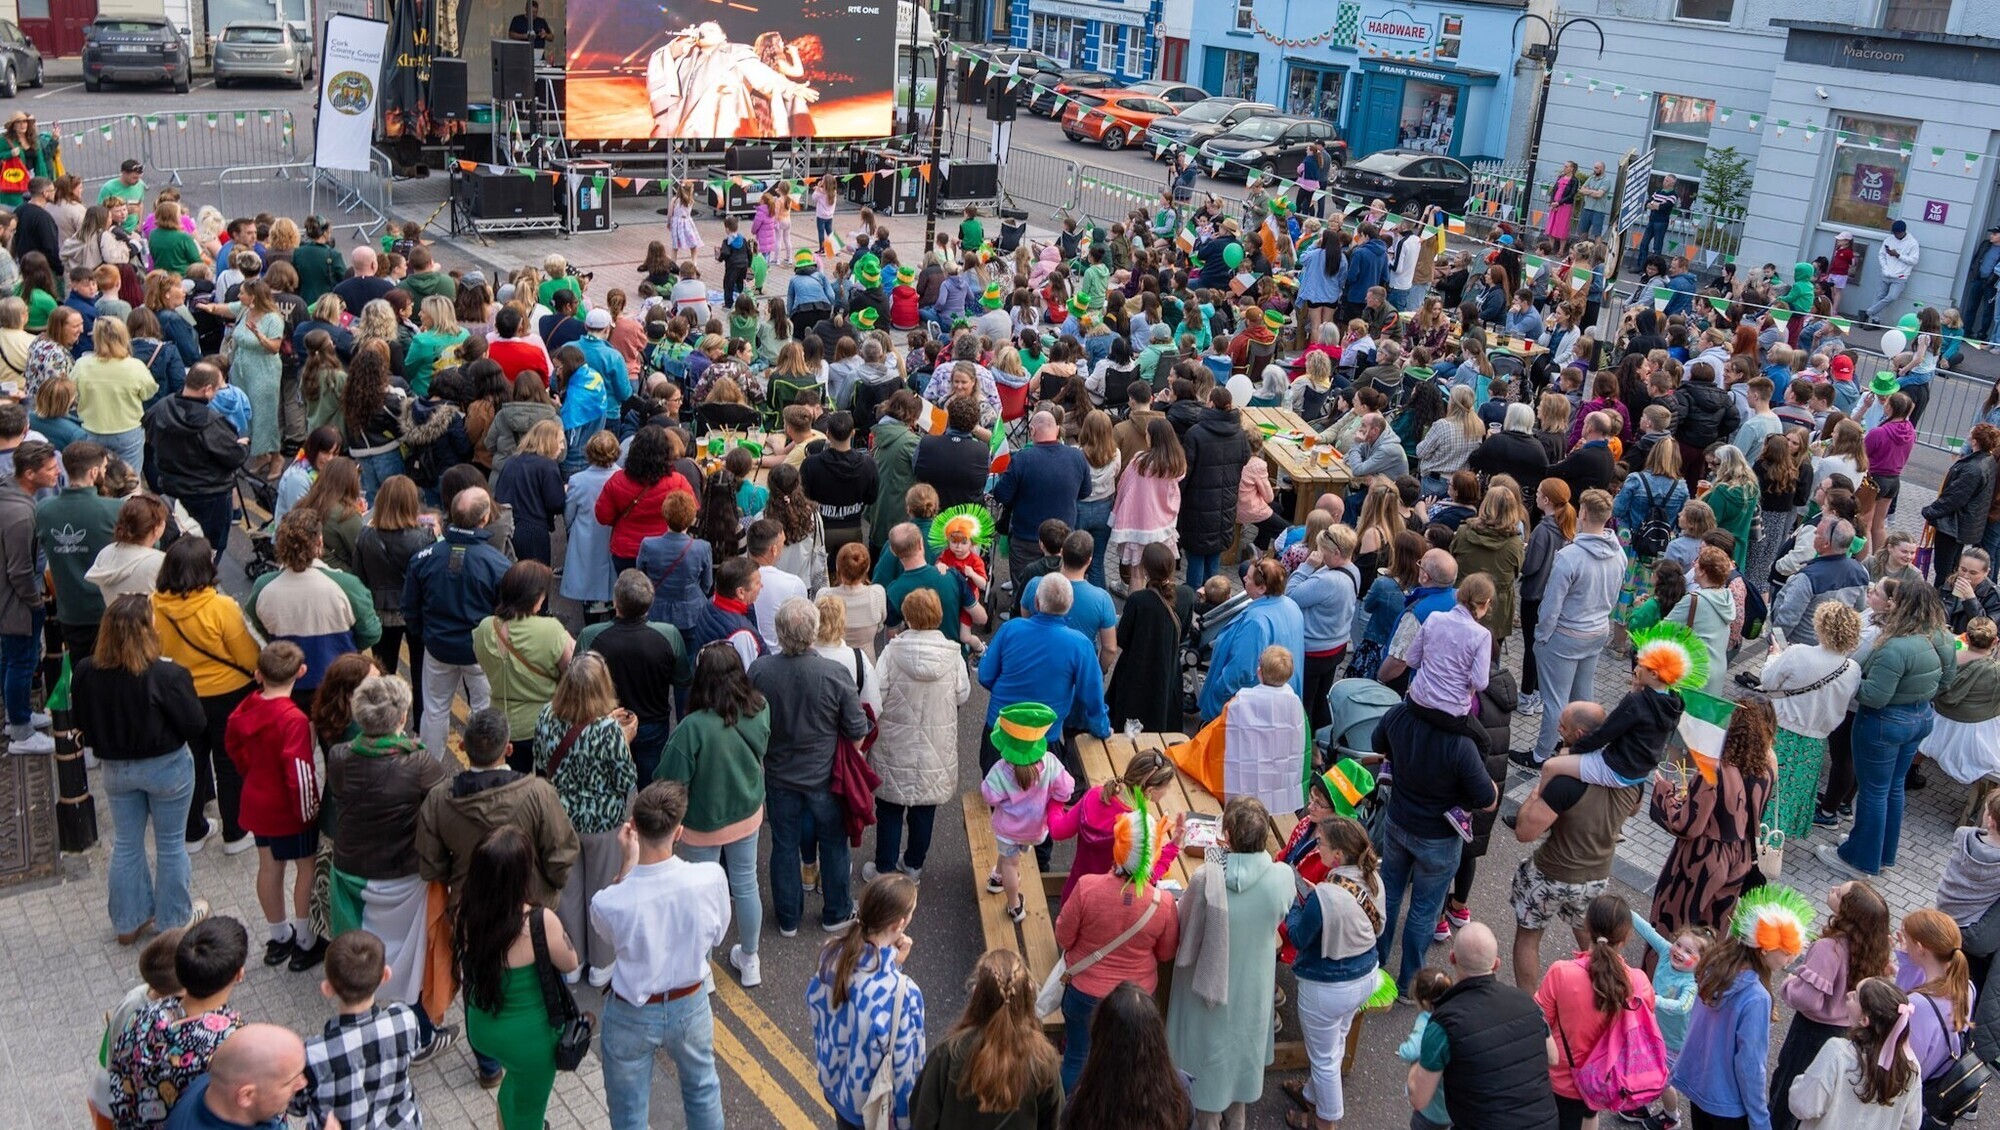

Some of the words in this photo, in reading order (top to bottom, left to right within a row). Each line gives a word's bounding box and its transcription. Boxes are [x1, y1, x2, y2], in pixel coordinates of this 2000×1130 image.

[1368, 21, 1425, 38] HARDWARE
[331, 39, 348, 47] Cork
[330, 45, 355, 55] County
[357, 50, 380, 59] Council
[1843, 45, 1905, 62] Macroom
[1379, 65, 1407, 75] FRANK
[1408, 69, 1446, 81] TWOMEY
[1858, 189, 1882, 201] AIB
[1927, 213, 1942, 221] AIB
[53, 544, 89, 553] adidas
